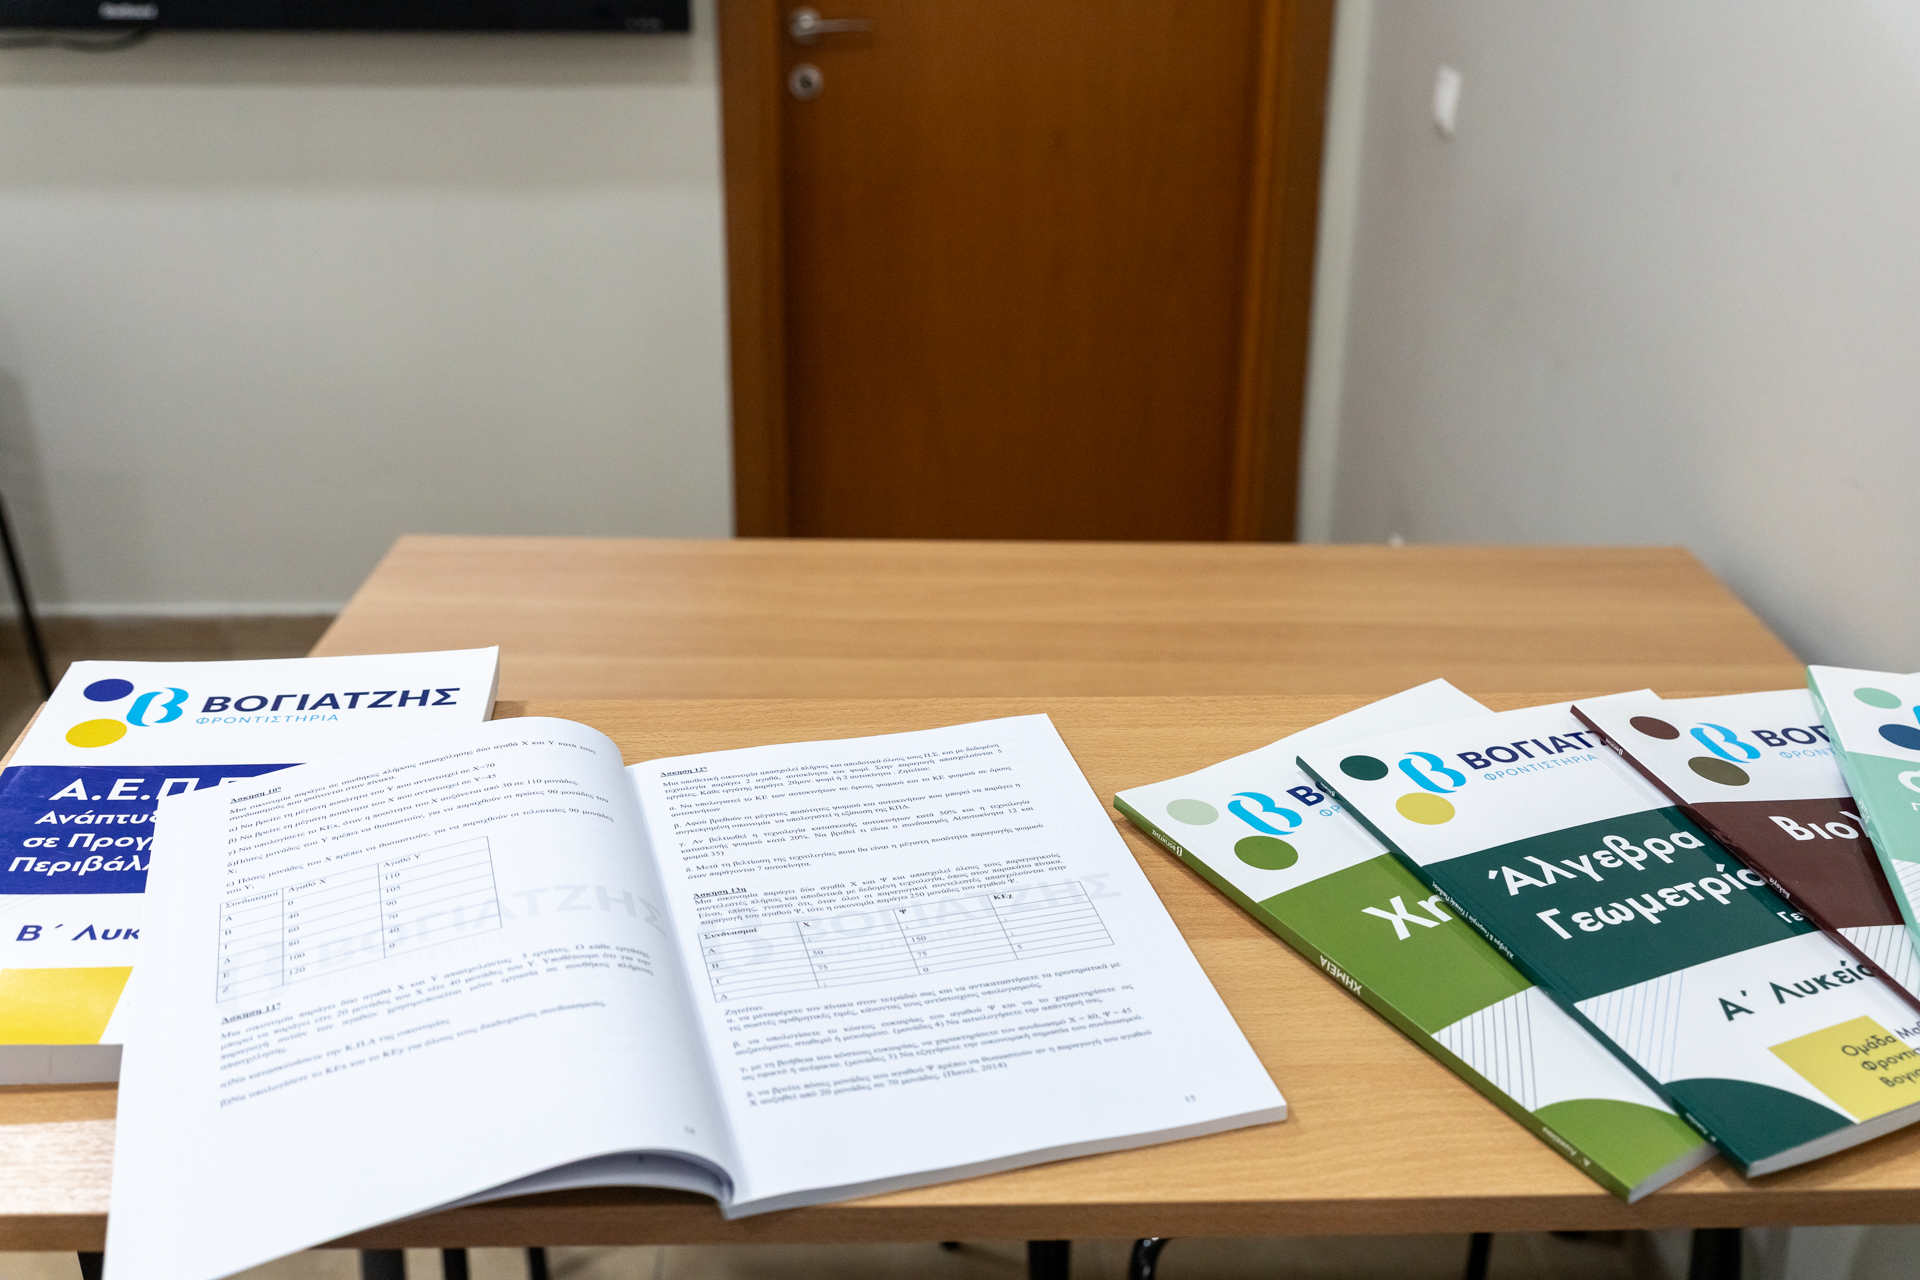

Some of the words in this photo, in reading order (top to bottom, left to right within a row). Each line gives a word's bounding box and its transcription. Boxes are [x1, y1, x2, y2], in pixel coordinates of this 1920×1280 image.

[201, 687, 461, 713] ΒΟΓΙΑΤΖΗΣ
[195, 713, 339, 725] ΦΡΟΝΤΙΣΤΗΡΙΑ
[1456, 730, 1597, 770] ΒΟΓΙΑΤ
[1483, 753, 1600, 781] ΦΡΟΝΤΙΣΤΗΡΙΑ
[23, 836, 61, 848] σε
[67, 833, 153, 851] Προγ
[8, 855, 150, 876] Περιβάλ
[1488, 831, 1705, 896] Άλγεβρα
[704, 927, 758, 940] Συνδυασμοί
[1320, 955, 1362, 995] ΧΗΜΕΙΑ
[1841, 1035, 1897, 1057] Ομάδα
